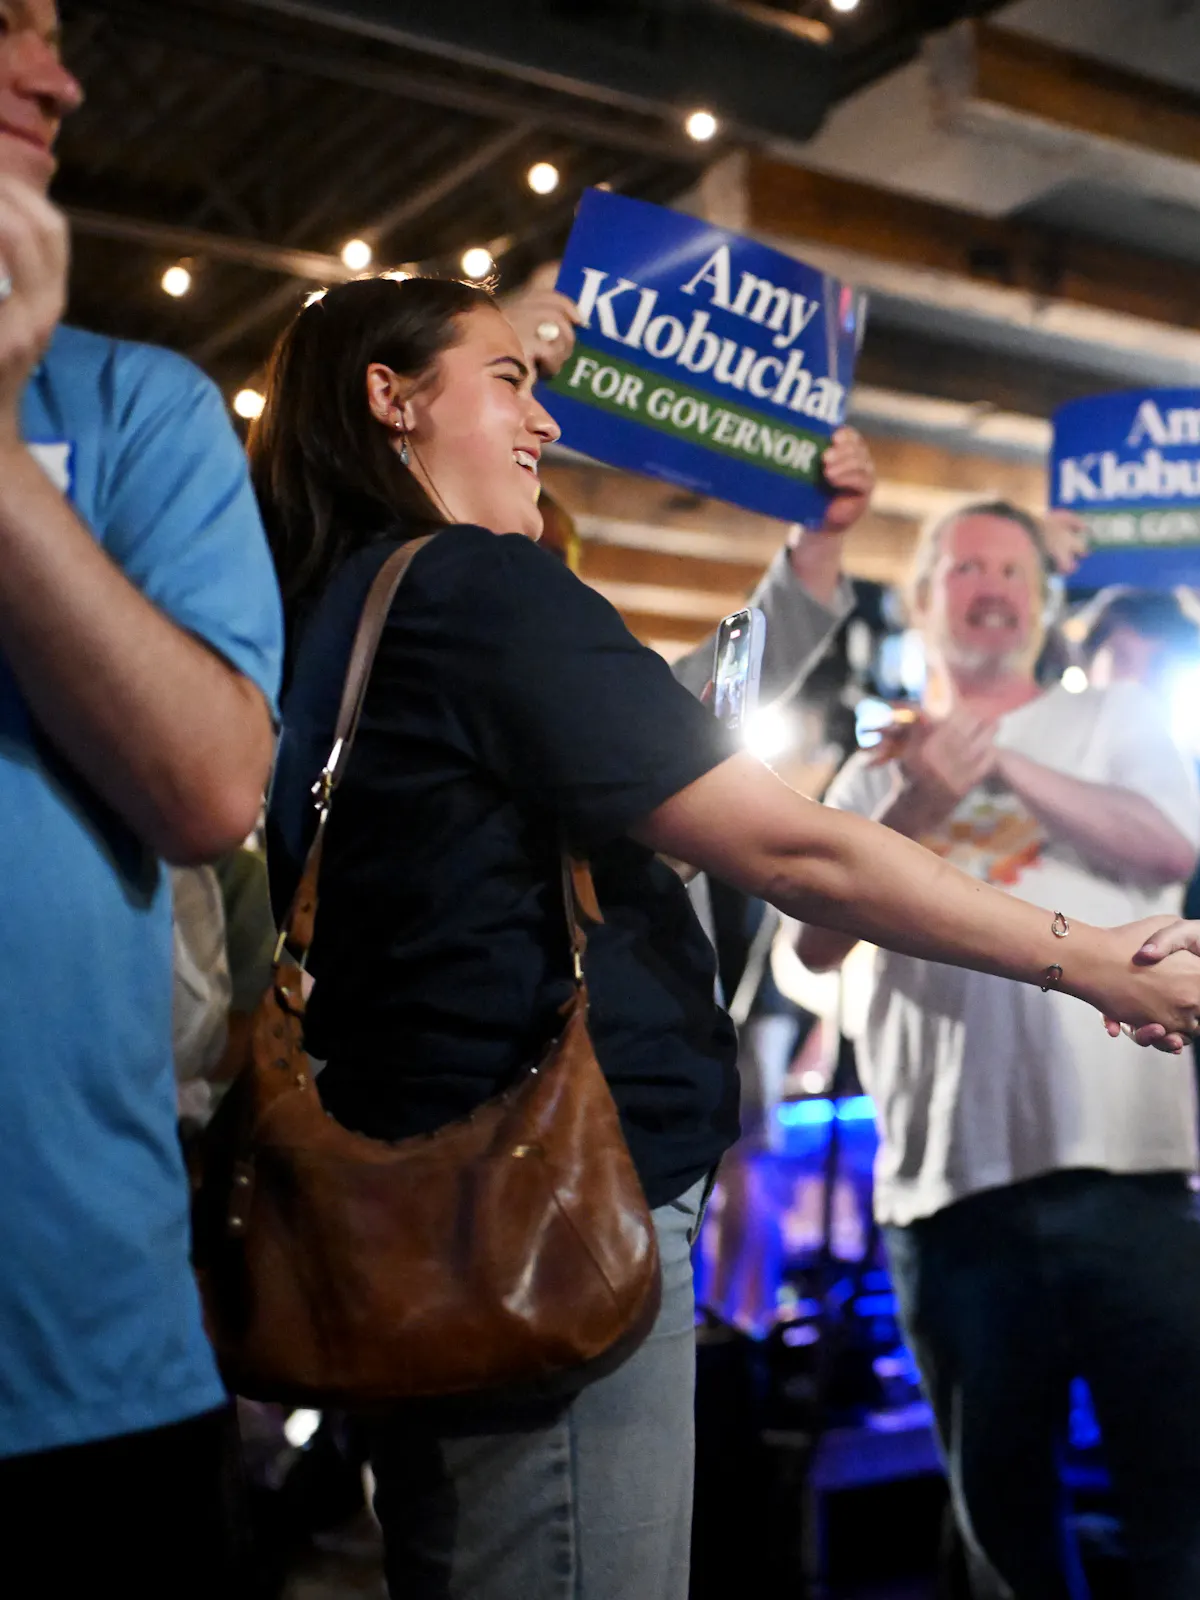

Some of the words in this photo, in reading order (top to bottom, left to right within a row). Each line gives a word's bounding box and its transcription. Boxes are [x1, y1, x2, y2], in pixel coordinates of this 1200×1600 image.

[680, 245, 820, 347] Amy
[568, 356, 645, 411] FOR
[645, 387, 818, 474] GOVERNOR
